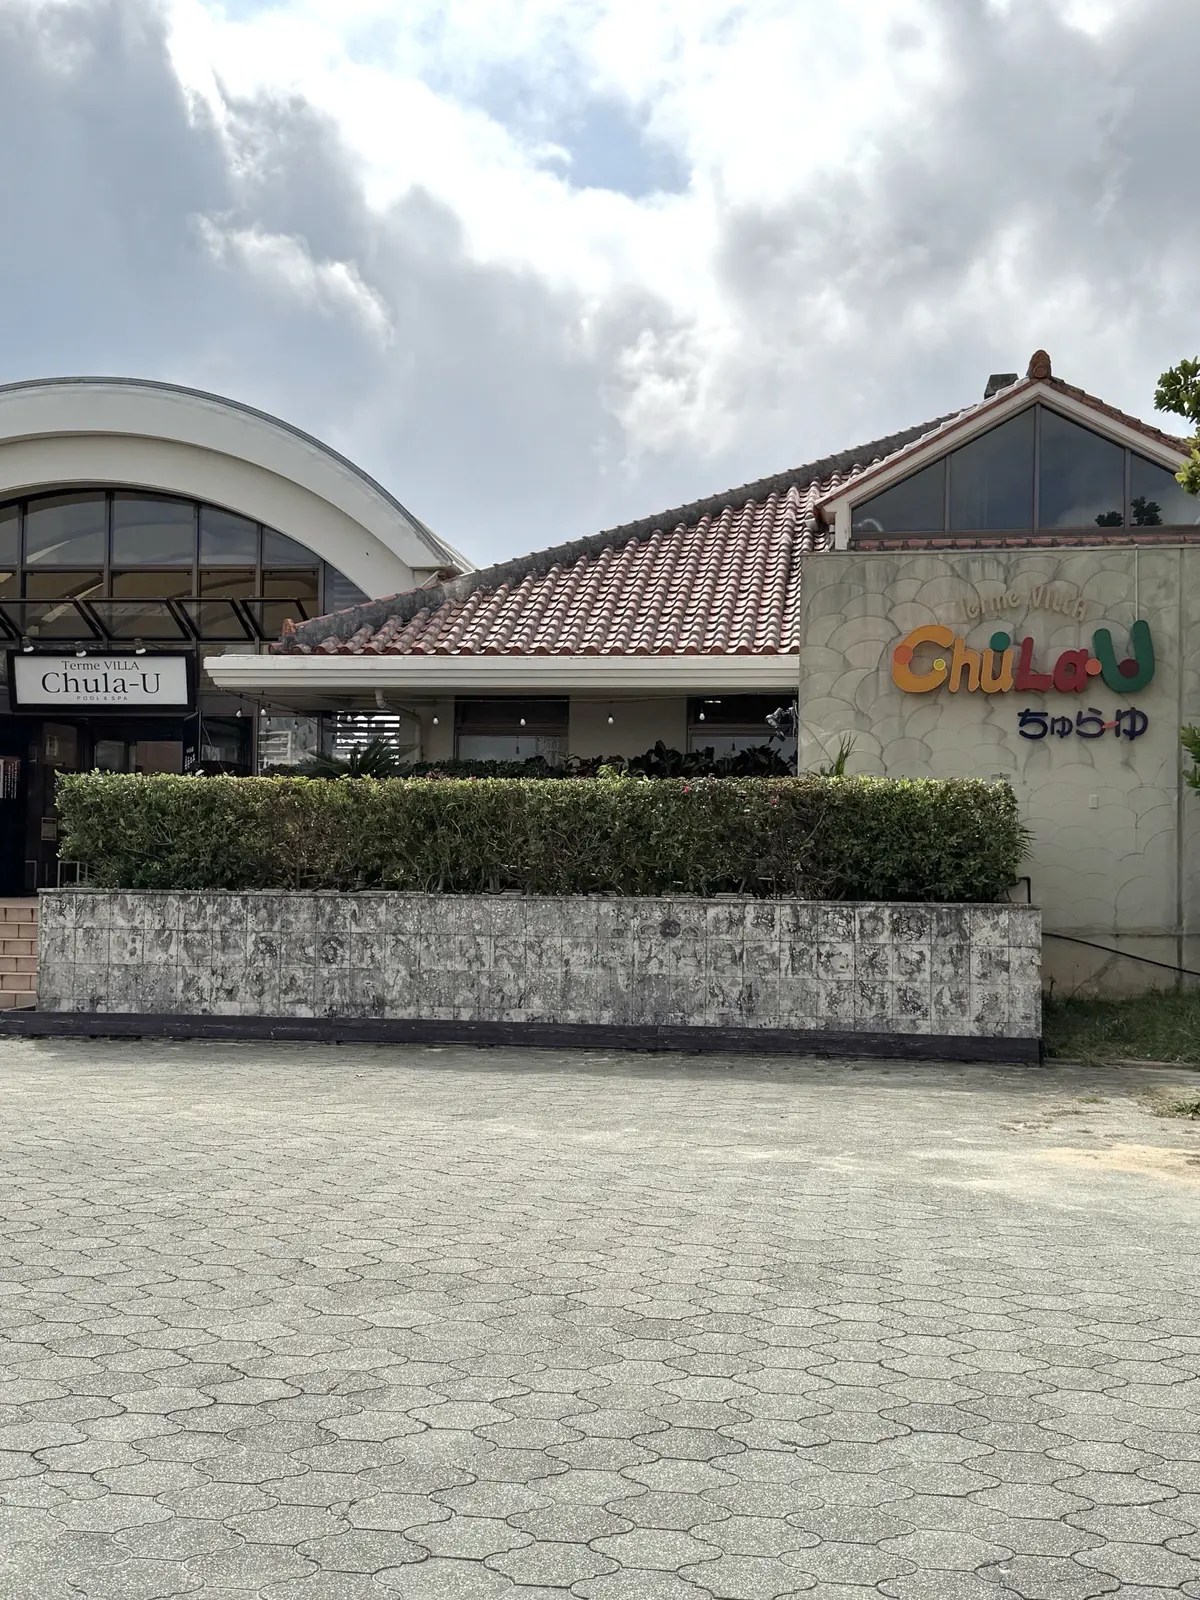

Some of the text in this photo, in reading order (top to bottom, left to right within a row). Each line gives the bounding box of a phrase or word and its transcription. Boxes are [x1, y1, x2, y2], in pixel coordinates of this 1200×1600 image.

[1031, 584, 1087, 621] VILLA
[61, 660, 139, 670] Terme VILLA
[41, 672, 160, 693] Chula-U
